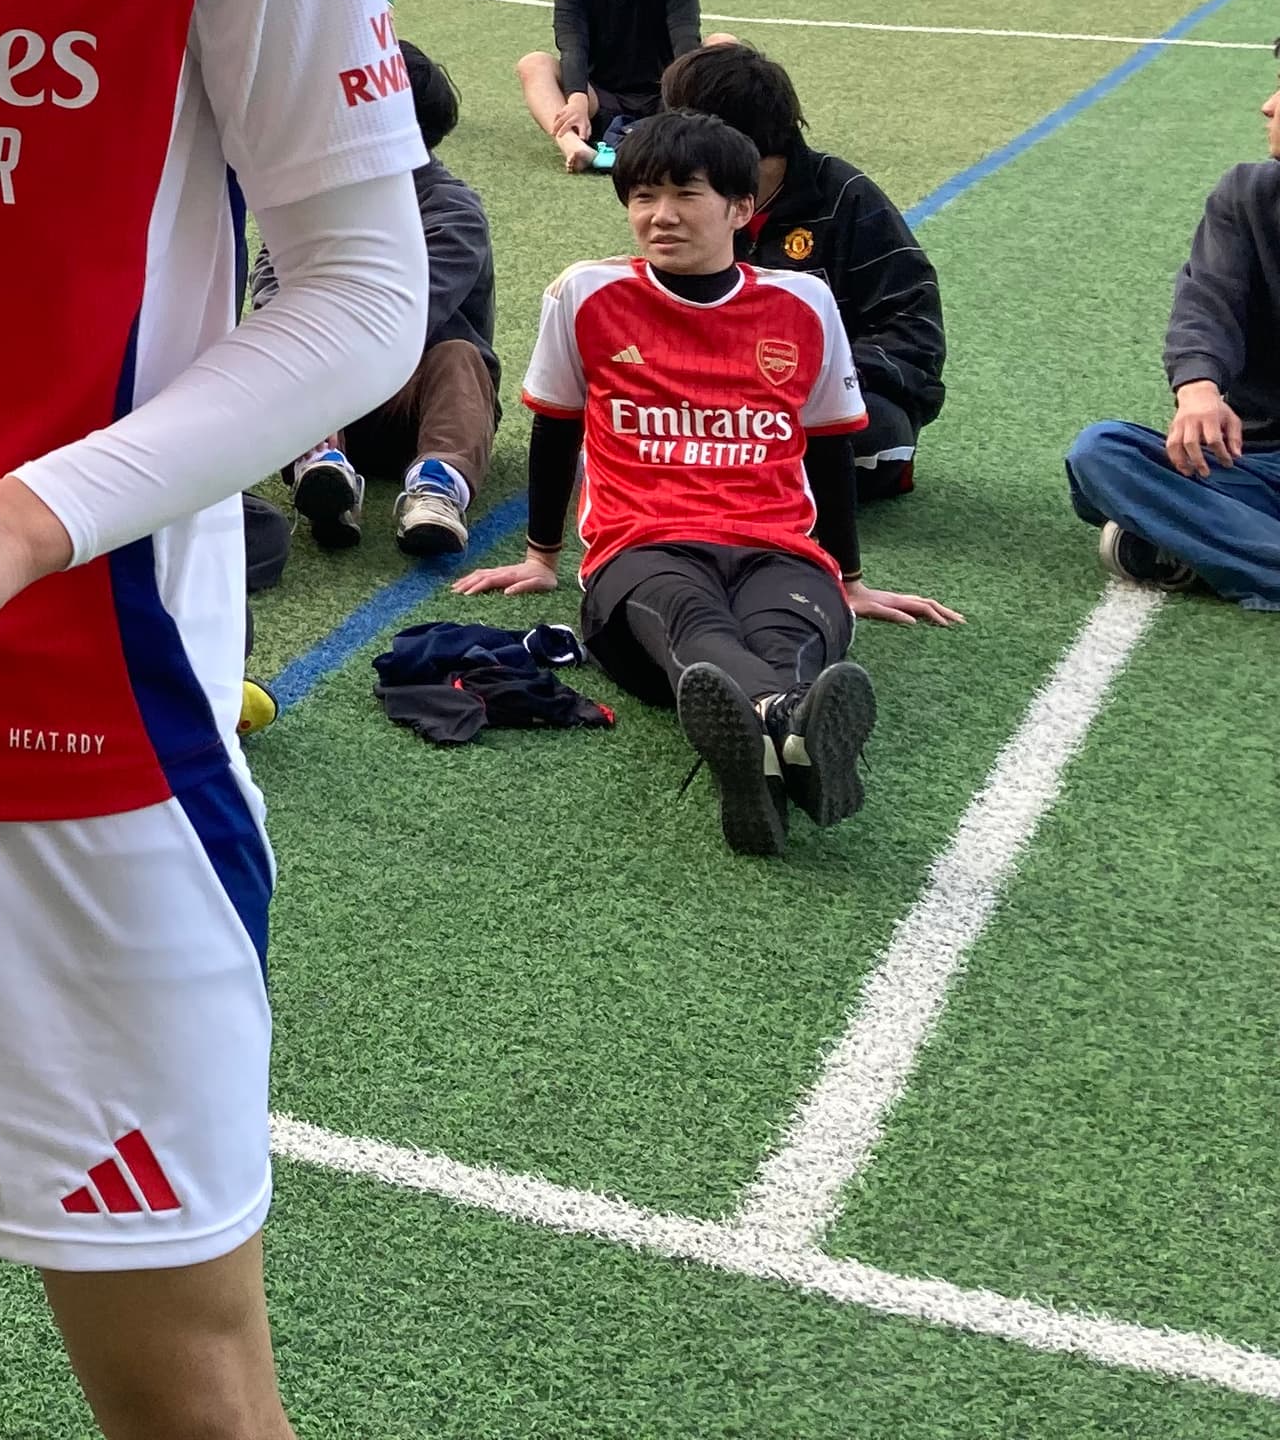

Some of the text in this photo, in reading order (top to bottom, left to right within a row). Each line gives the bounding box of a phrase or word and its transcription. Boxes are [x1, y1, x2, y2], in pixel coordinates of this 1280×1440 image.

[609, 398, 793, 442] Emirates
[639, 439, 678, 464] FLY
[8, 727, 105, 756] HEAT.RDY
